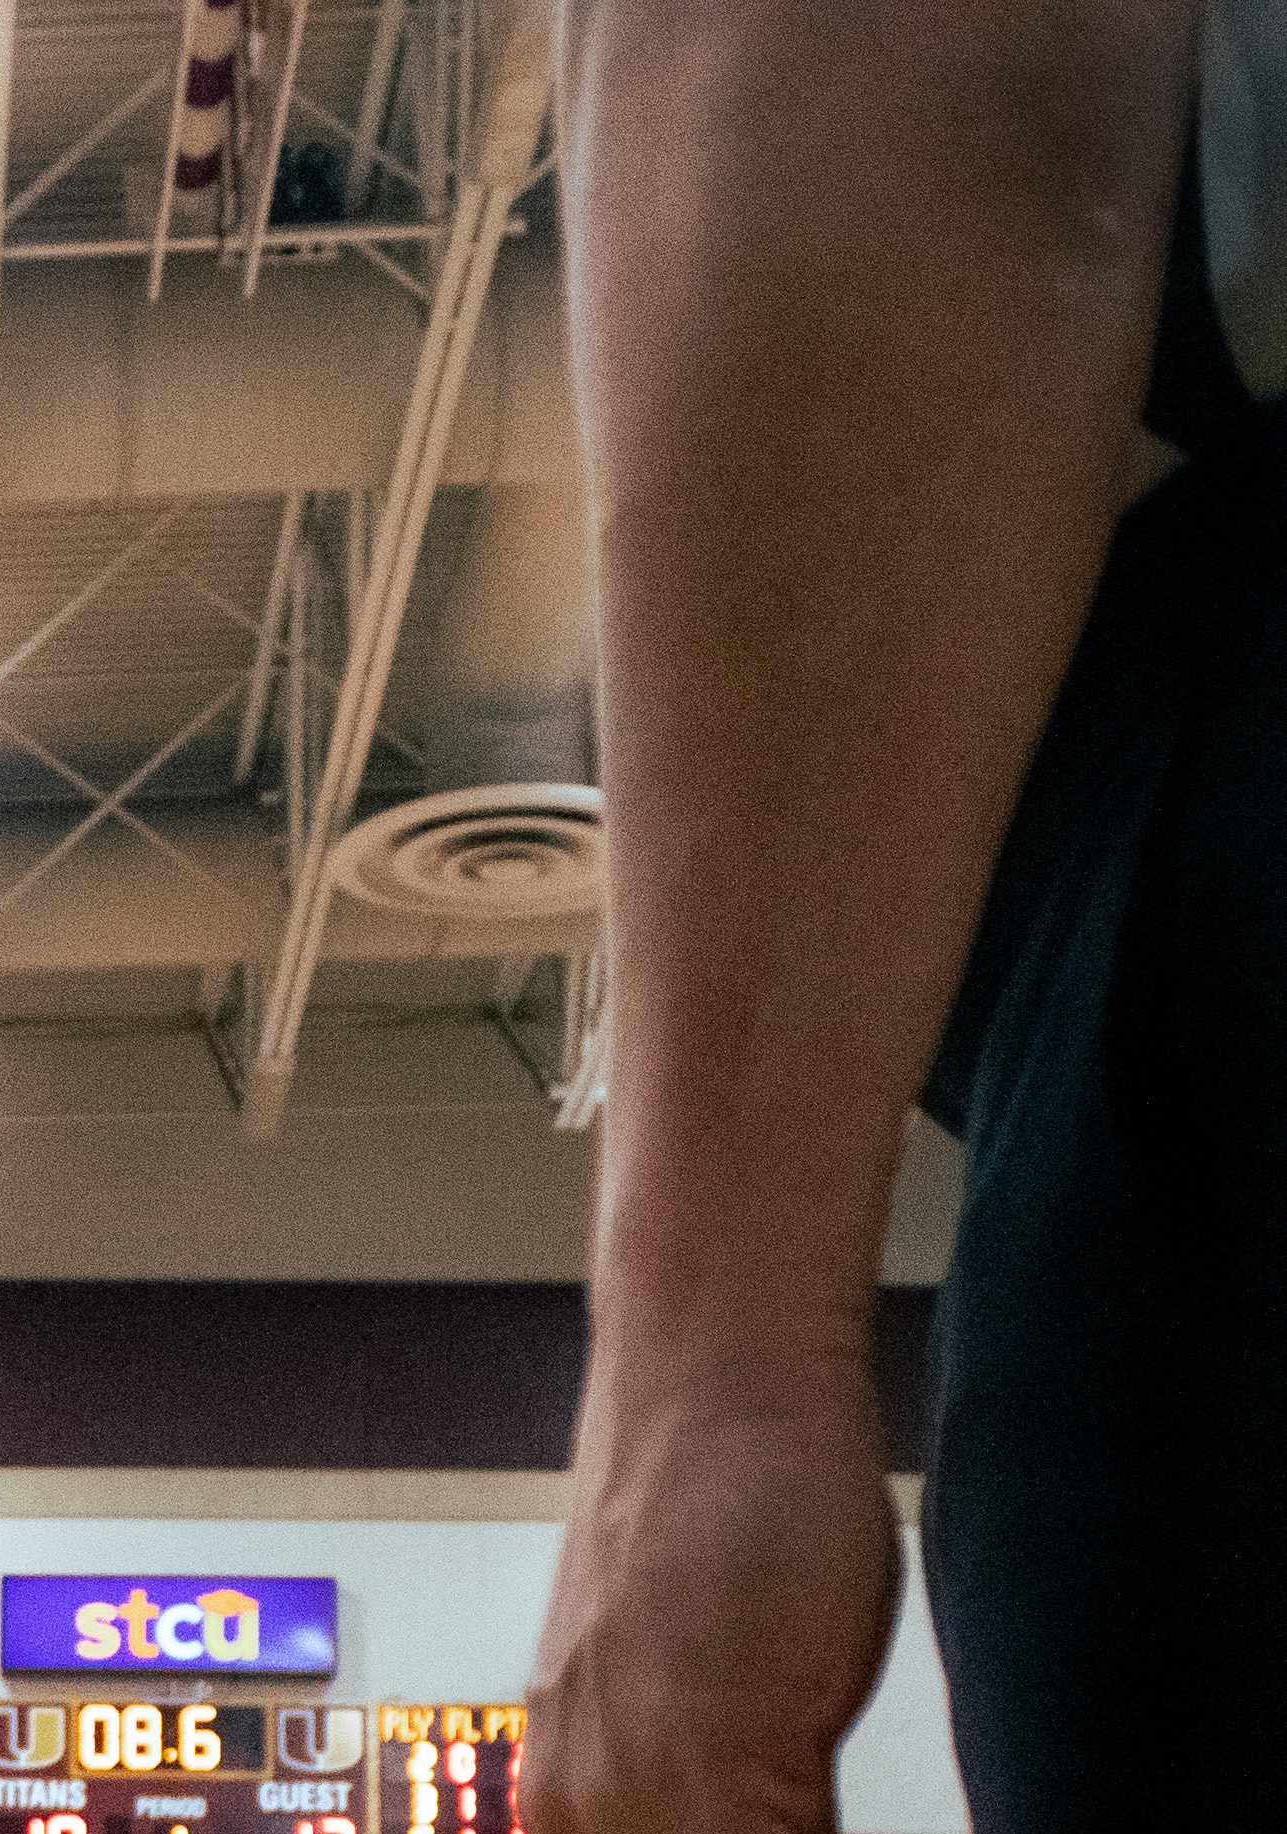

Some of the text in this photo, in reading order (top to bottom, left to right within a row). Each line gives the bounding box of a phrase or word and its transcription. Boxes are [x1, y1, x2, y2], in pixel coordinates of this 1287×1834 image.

[75, 1588, 260, 1661] stcu
[78, 1703, 222, 1772] 08.6
[380, 1706, 528, 1744] PLY FL PT
[406, 1740, 439, 1783] 2
[444, 1740, 477, 1785] 0
[258, 1781, 350, 1812] GUEST
[457, 1785, 477, 1822] 1
